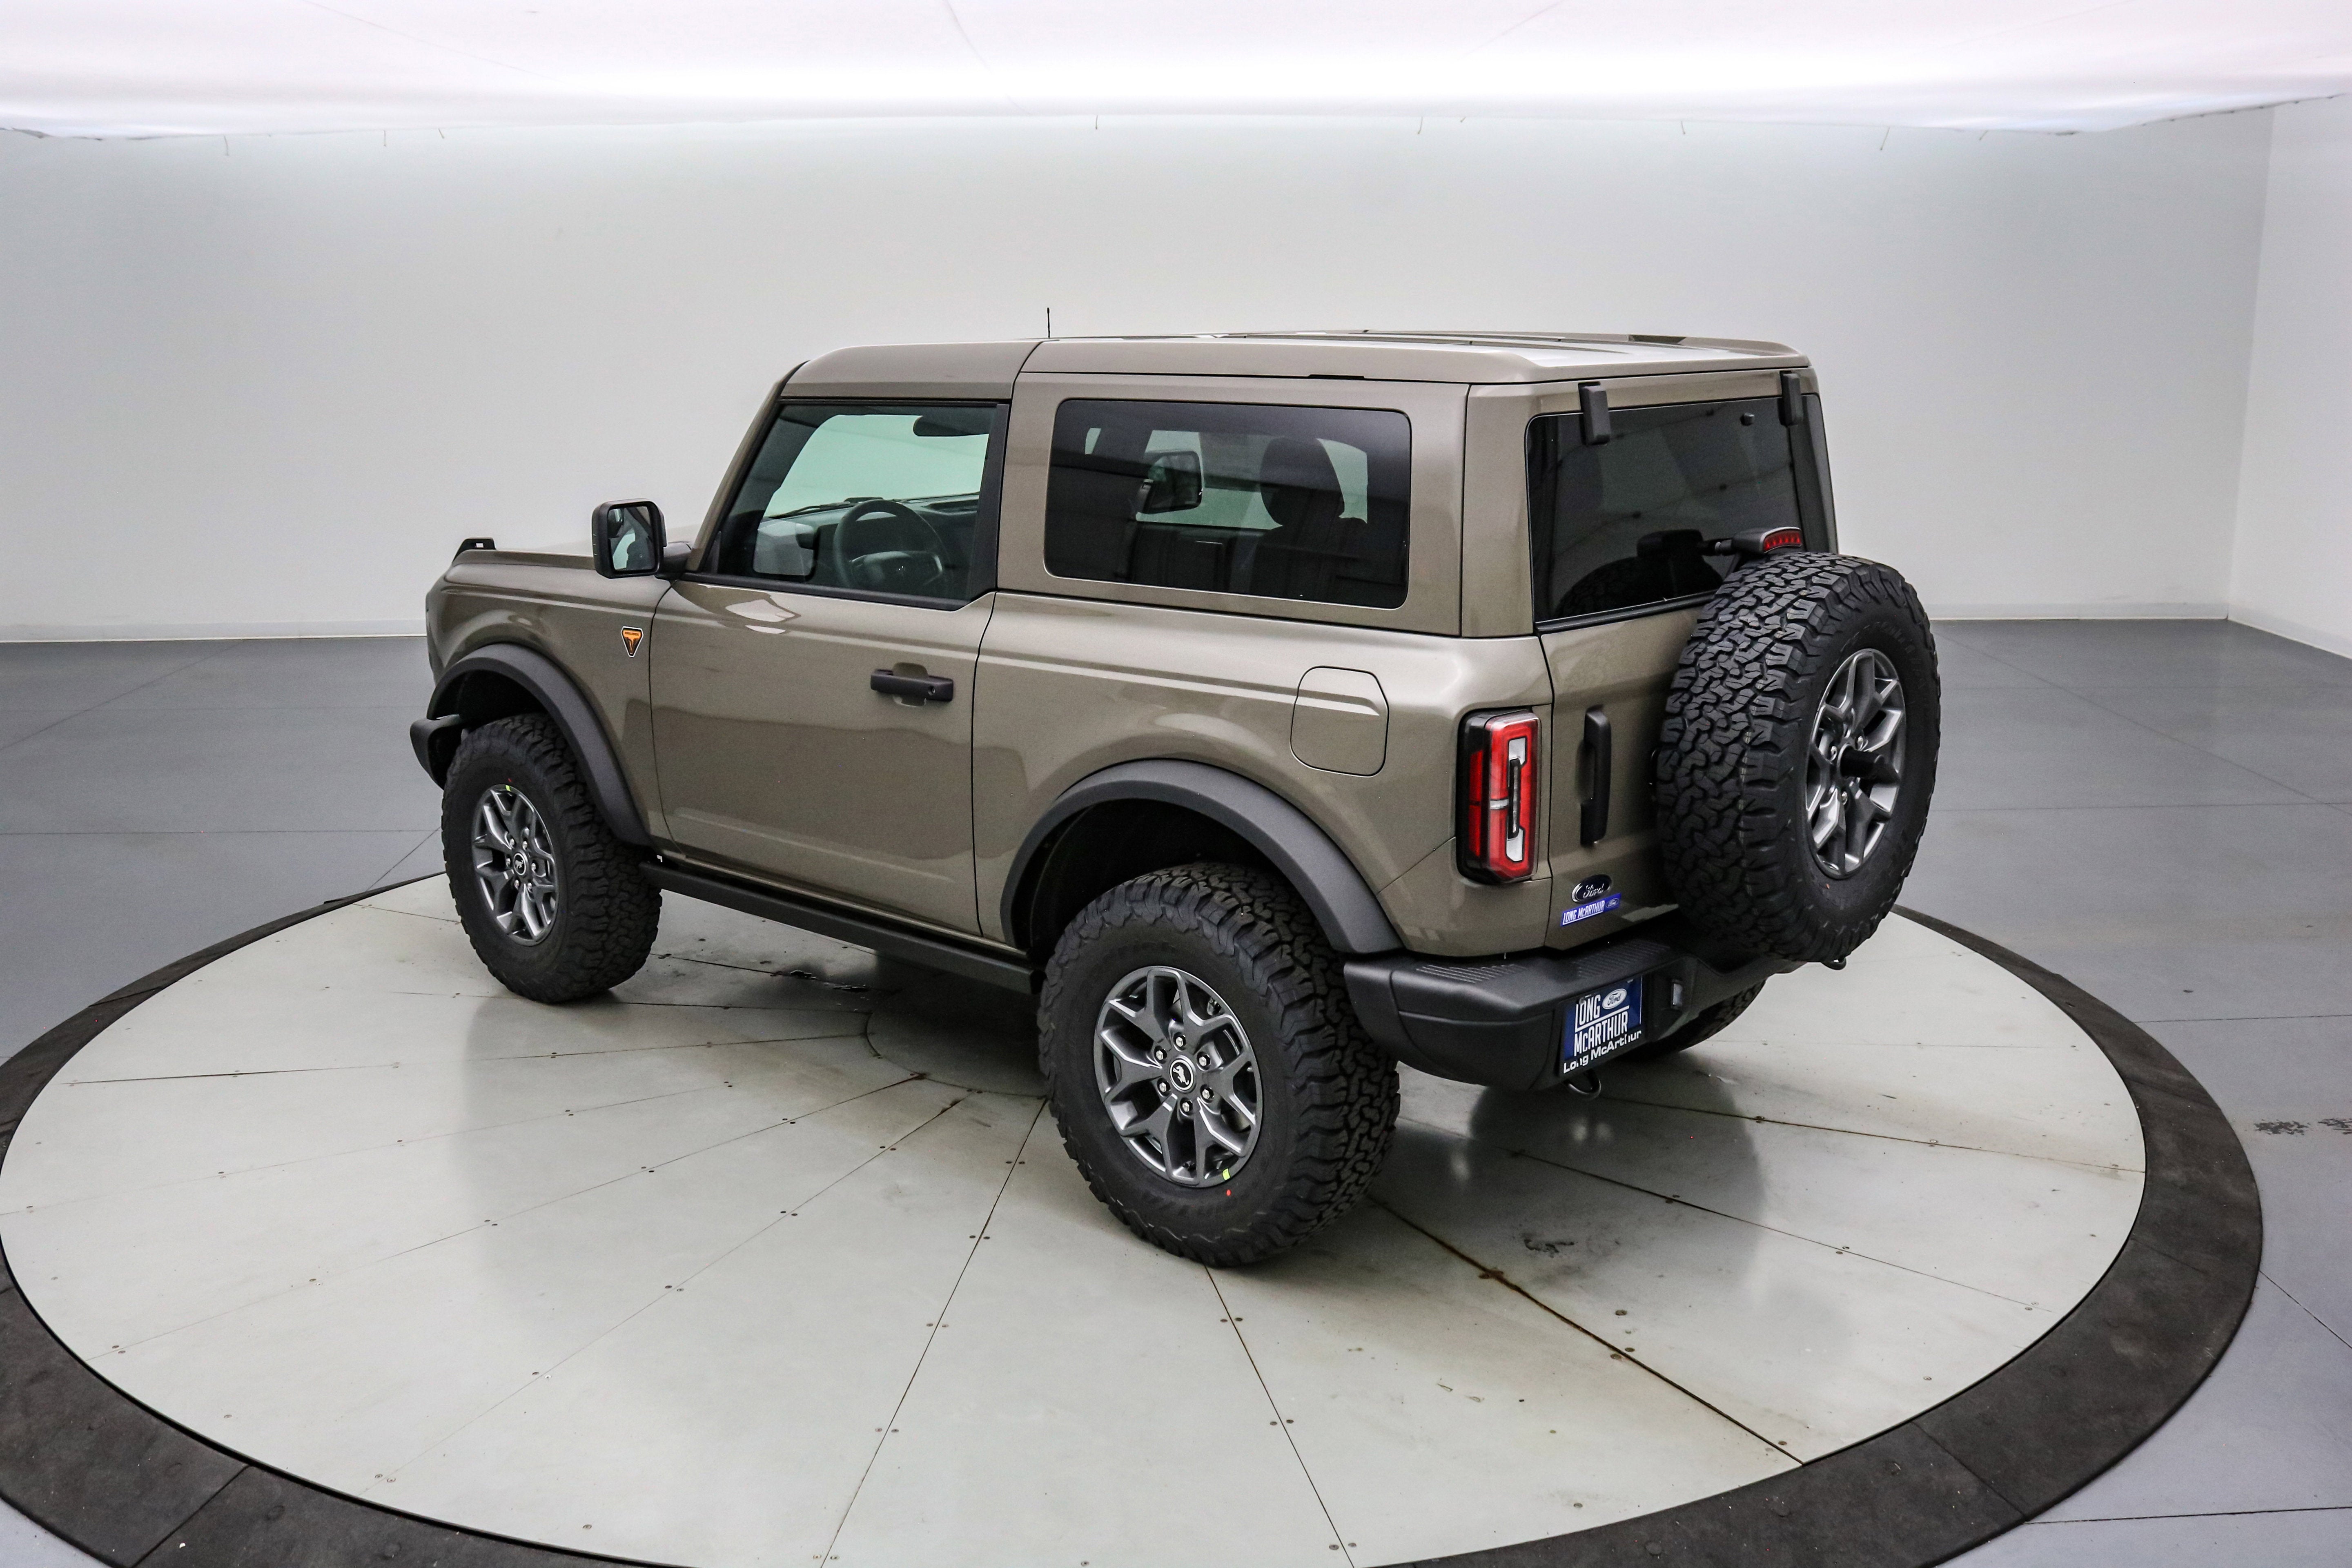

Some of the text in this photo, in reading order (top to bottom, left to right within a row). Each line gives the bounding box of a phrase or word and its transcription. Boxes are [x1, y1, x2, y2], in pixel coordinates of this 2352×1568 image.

[1583, 883, 1604, 899] Ford
[1563, 900, 1605, 925] LONG McARTHUR
[1607, 992, 1622, 1006] Ford
[1575, 994, 1601, 1033] LONG
[1574, 1011, 1628, 1056] McARTHUR
